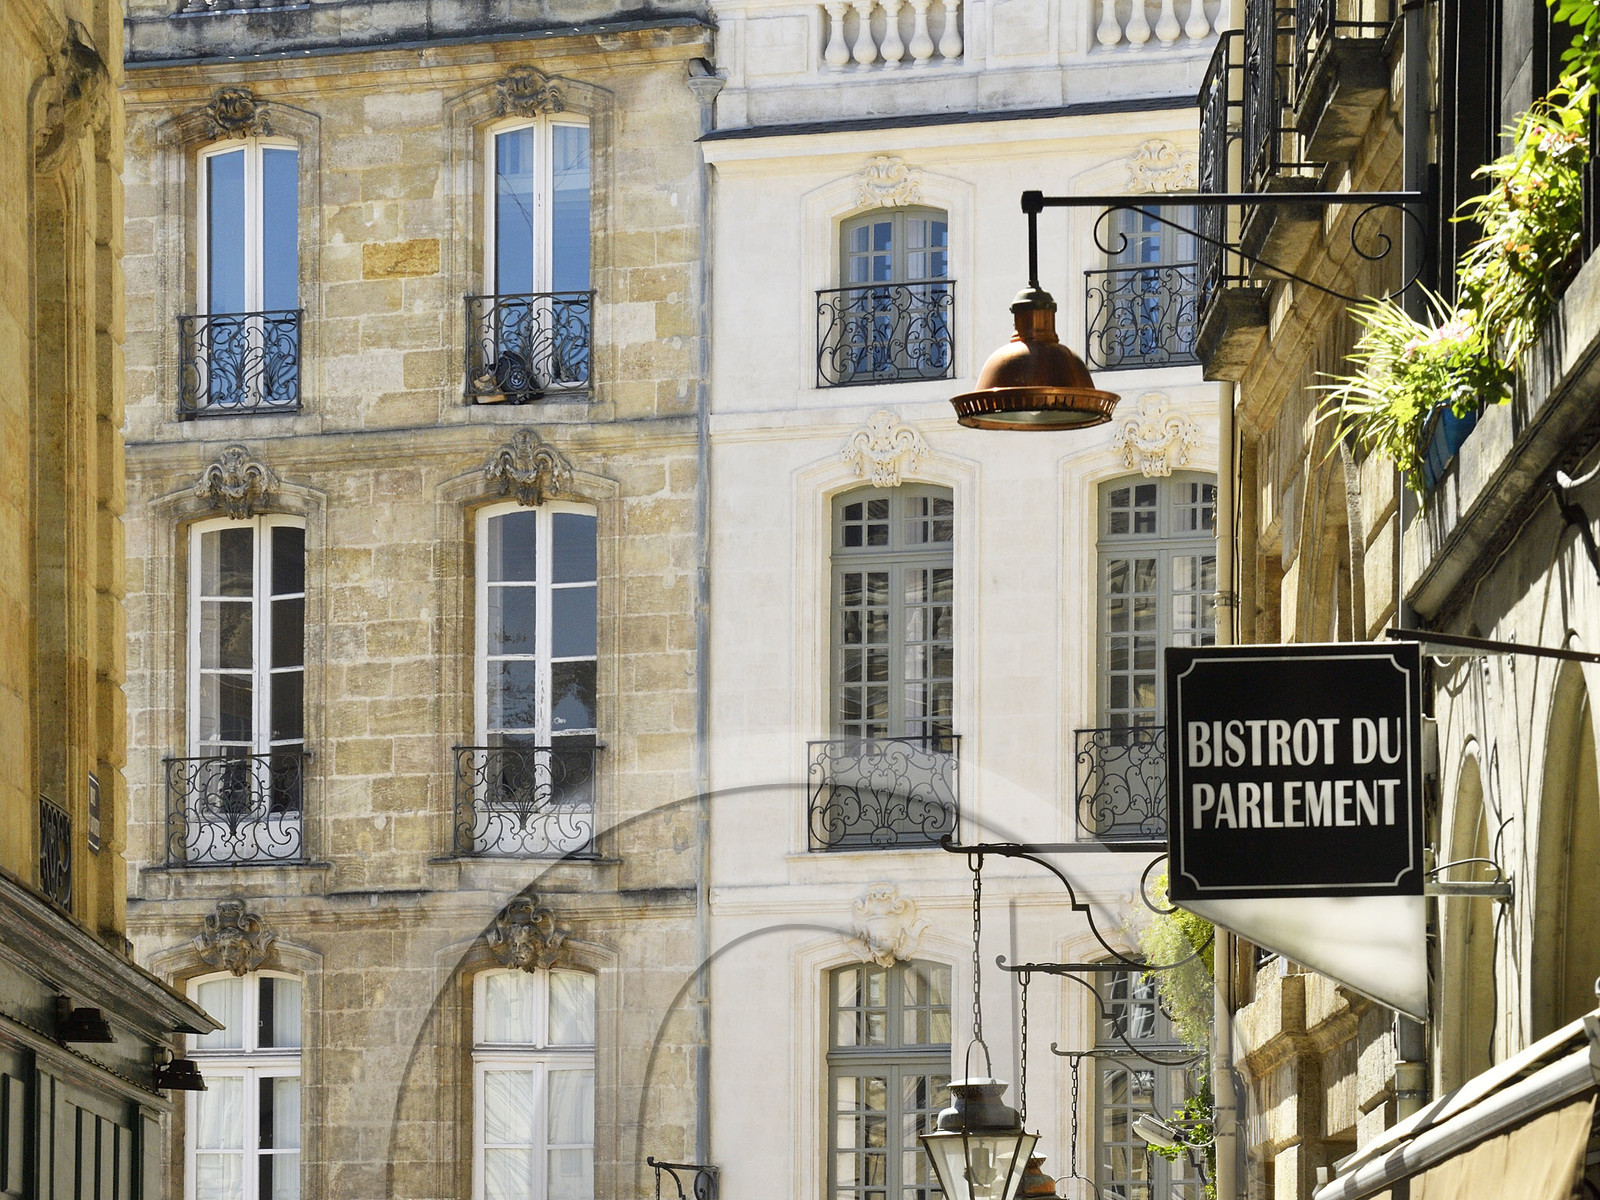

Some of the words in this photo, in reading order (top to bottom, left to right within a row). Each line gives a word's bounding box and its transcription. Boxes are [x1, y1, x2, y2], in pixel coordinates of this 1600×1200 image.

[1188, 718, 1340, 767] BISTROT
[1352, 717, 1401, 765] DU
[1192, 779, 1401, 829] PARLEMENT
